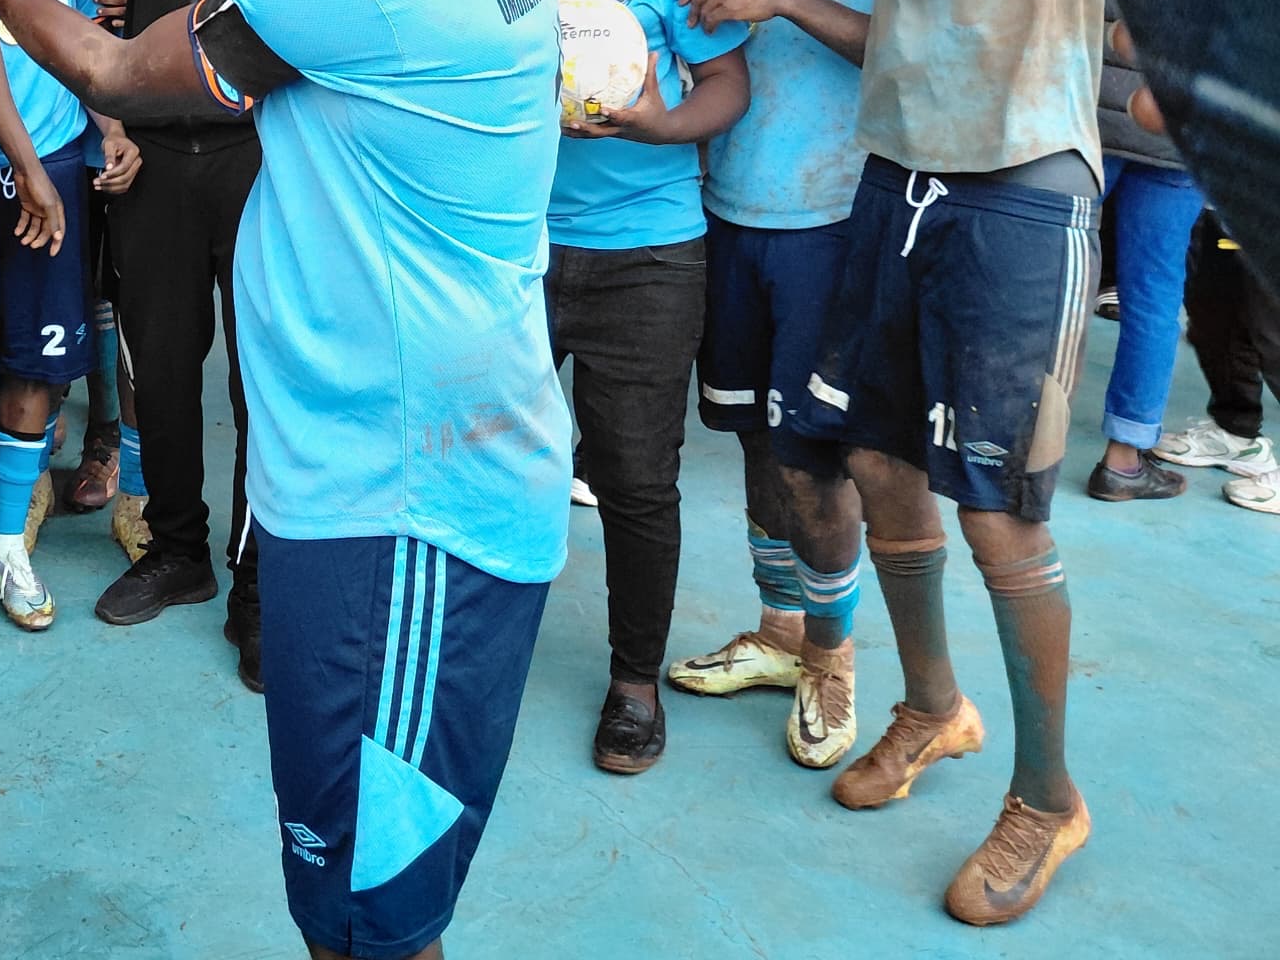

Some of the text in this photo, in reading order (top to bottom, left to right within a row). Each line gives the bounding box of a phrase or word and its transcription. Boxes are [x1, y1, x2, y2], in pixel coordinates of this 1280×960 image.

[41, 324, 66, 356] 2
[966, 455, 1004, 468] umbro
[291, 842, 326, 867] umbro
